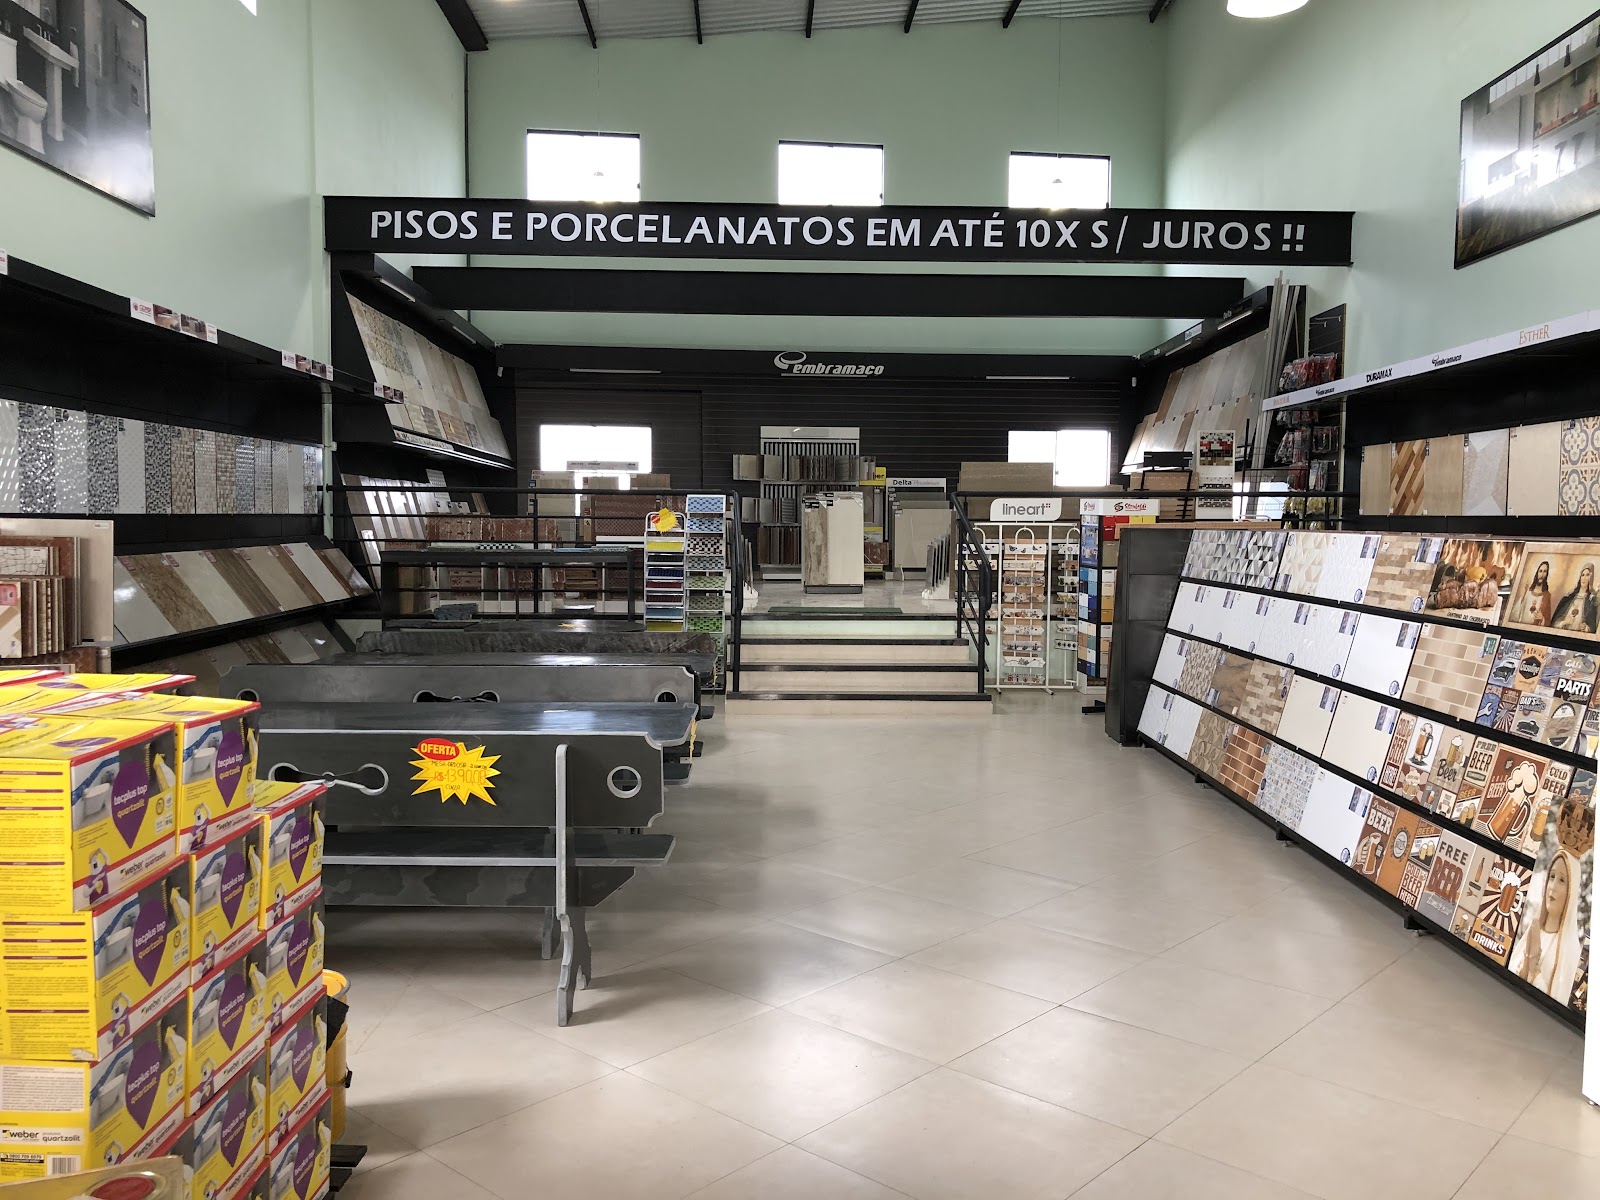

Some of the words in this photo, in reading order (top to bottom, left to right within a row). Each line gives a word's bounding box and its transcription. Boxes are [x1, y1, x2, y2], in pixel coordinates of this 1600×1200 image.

[370, 210, 478, 240] PISOS
[491, 211, 513, 240] E
[526, 212, 855, 246] PORCELANATOS
[866, 218, 920, 247] EM
[930, 212, 1004, 248] ATÉ
[1016, 218, 1079, 248] 10X
[1143, 220, 1272, 252] JUROS
[1366, 368, 1393, 383] DURAMAX
[1002, 503, 1045, 516] lineart
[1557, 678, 1592, 696] PARTS
[1520, 696, 1536, 705] DAD'S
[420, 743, 456, 756] OFERTA
[218, 756, 235, 768] tecplus
[1436, 758, 1457, 782] Beer
[1470, 751, 1492, 772] BEER
[1550, 767, 1568, 780] COLD
[114, 788, 137, 806] tecplus
[137, 784, 148, 796] top
[1487, 782, 1506, 798] BEER
[1542, 778, 1566, 797] BEER
[117, 799, 144, 818] quartzolit
[1367, 809, 1392, 835] BEER
[1438, 841, 1468, 866] FREE
[125, 860, 144, 876] weber
[1406, 863, 1421, 878] COLD
[1402, 875, 1422, 896] BEER
[1400, 889, 1418, 907] HERE!
[135, 927, 156, 948] tecplus
[156, 920, 166, 932] top
[1474, 932, 1505, 955] DRINKS
[138, 935, 164, 959] quartzolit
[127, 1070, 150, 1094] tecplus
[150, 1062, 160, 1074] top
[10, 1130, 39, 1138] weber
